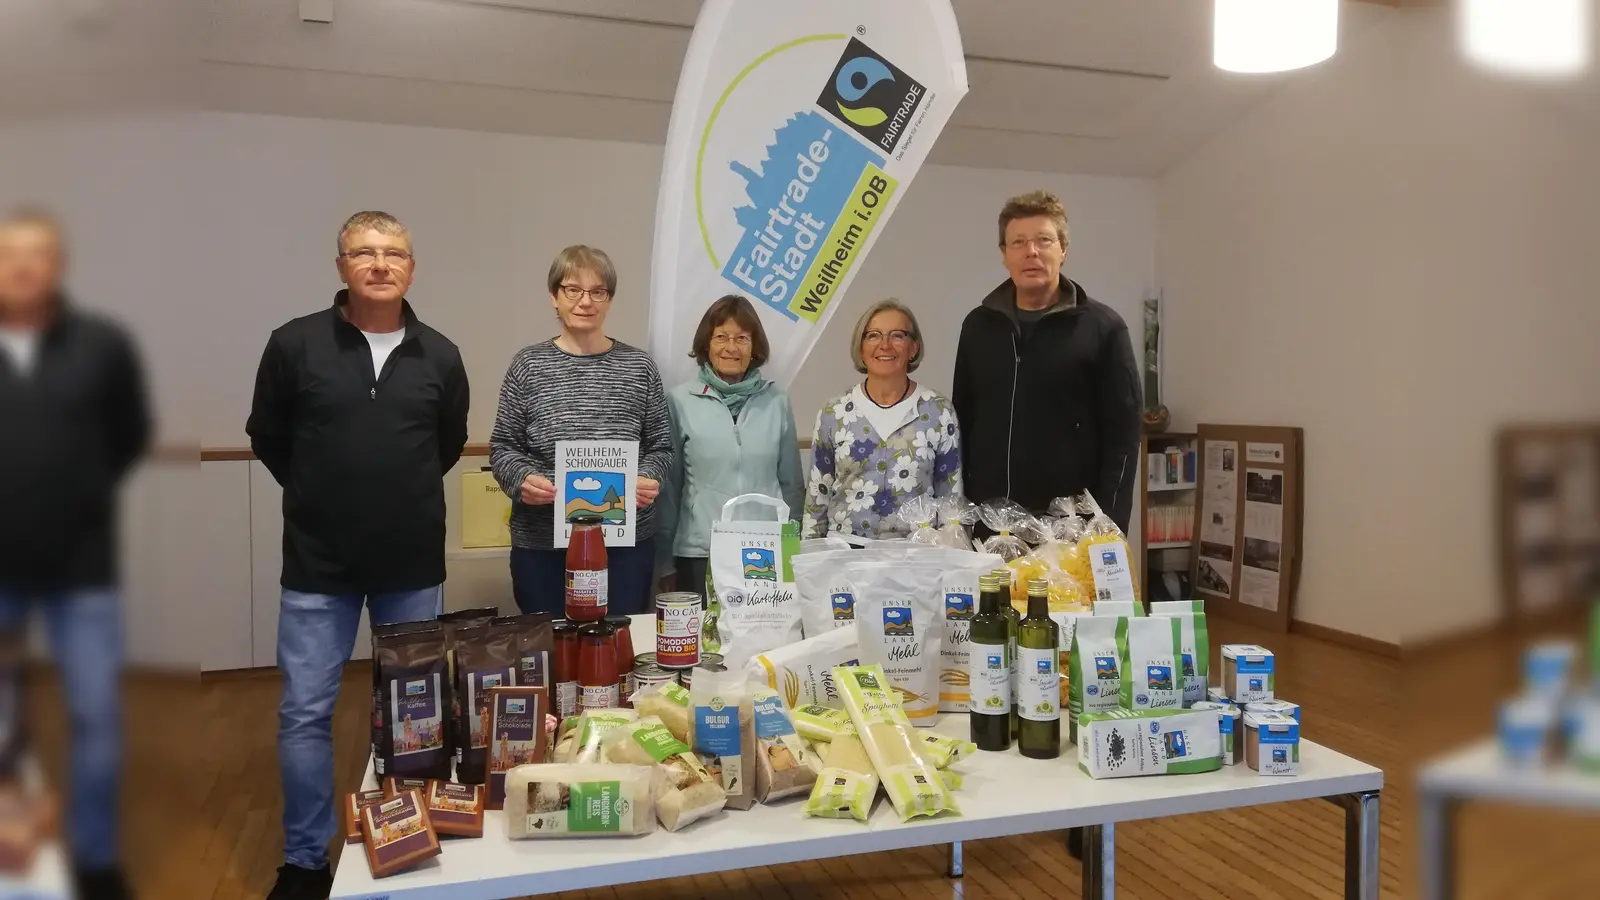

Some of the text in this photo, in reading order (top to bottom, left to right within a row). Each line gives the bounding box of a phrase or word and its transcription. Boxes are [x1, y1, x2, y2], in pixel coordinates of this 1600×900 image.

[881, 84, 921, 148] FAIRTRADE
[732, 129, 832, 288] Fairtrade-
[800, 174, 888, 315] Weilheim i.OB
[760, 212, 826, 303] Stadt
[565, 447, 628, 457] WEILHEIM-
[565, 458, 628, 468] SCHONGAUER
[744, 581, 778, 589] LAND
[747, 590, 793, 608] Kartoffeln
[666, 607, 699, 617] NO CAP
[657, 637, 696, 646] POMODORO
[657, 644, 697, 653] PELATO BIO
[888, 643, 920, 662] Mehl
[883, 667, 922, 675] inkel-Feinmehl
[820, 670, 838, 702] Mehl
[1100, 687, 1121, 698] Linse
[407, 701, 426, 709] Kaffee
[754, 703, 776, 713] BULGUR
[862, 702, 900, 714] Spaghetti
[1150, 697, 1177, 709] Linsen
[705, 715, 730, 724] BULGUR
[1183, 729, 1192, 756] UNSER
[1148, 736, 1160, 767] Linsen
[592, 799, 601, 816] REIS
[601, 786, 611, 828] LANGKORN-
